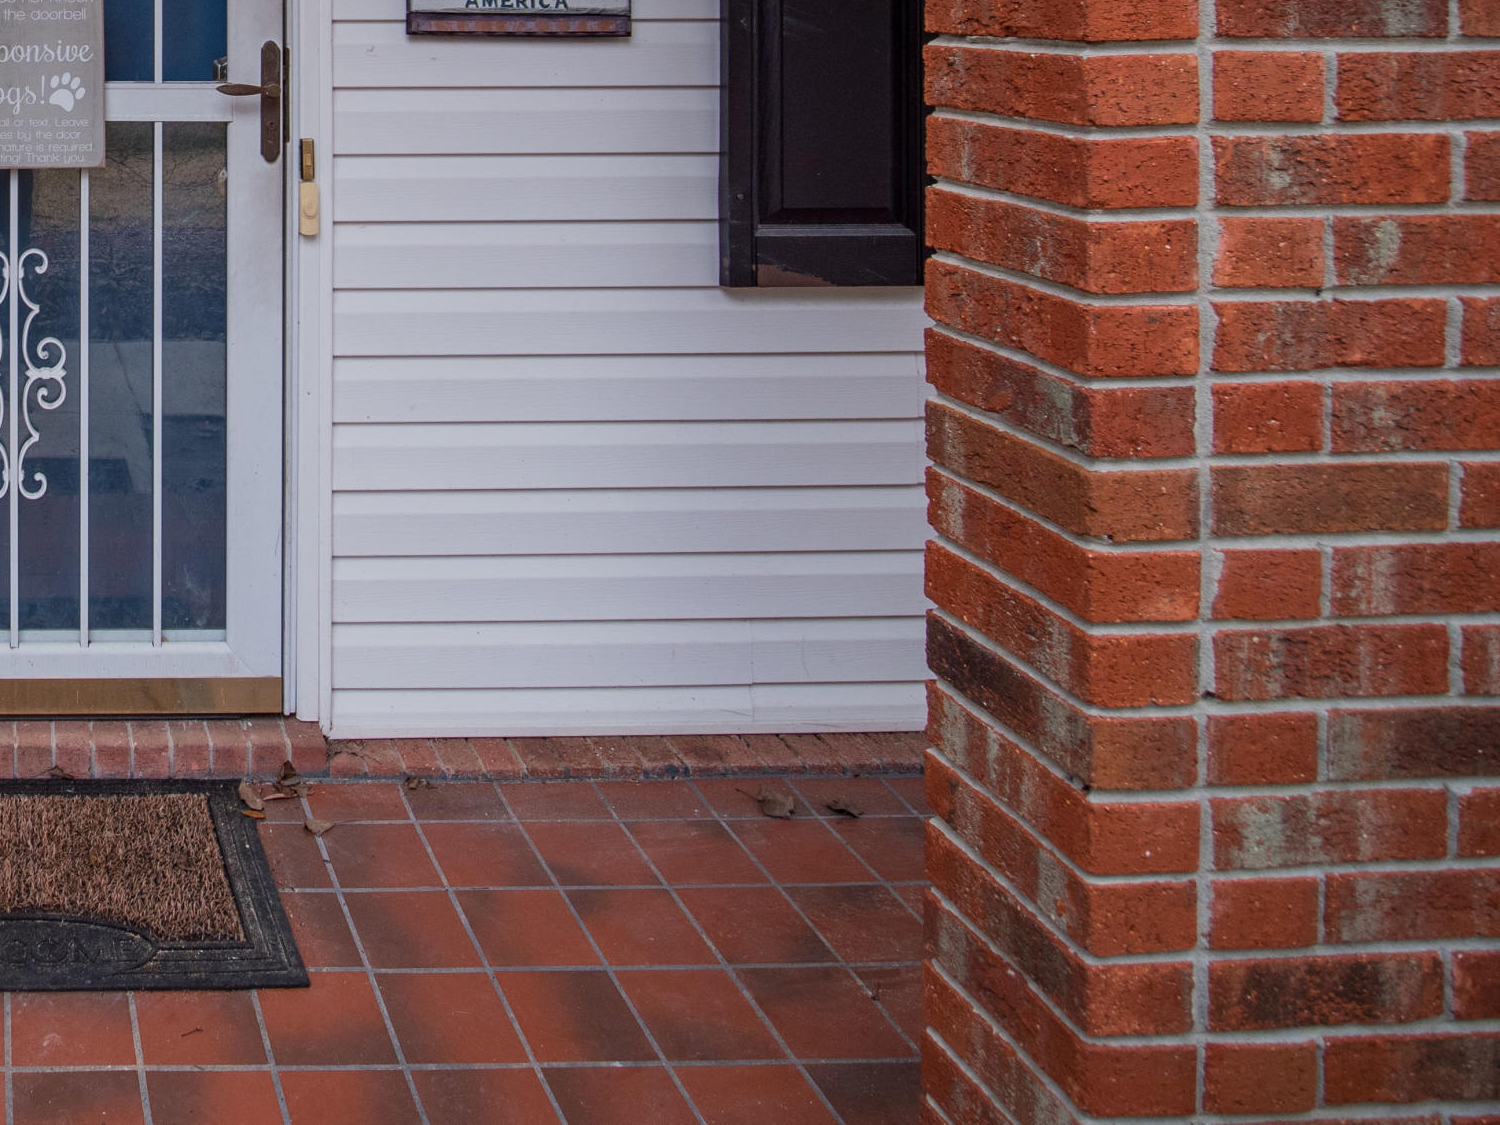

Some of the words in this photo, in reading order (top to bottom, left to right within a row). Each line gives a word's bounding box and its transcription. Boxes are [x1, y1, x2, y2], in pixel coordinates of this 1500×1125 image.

[4, 9, 25, 21] the
[31, 9, 86, 20] doorbell
[55, 118, 88, 127] Leave
[17, 131, 31, 141] by
[36, 131, 52, 139] the
[56, 131, 81, 139] door
[36, 143, 44, 152] is
[48, 142, 92, 152] required
[25, 153, 59, 162] Thank
